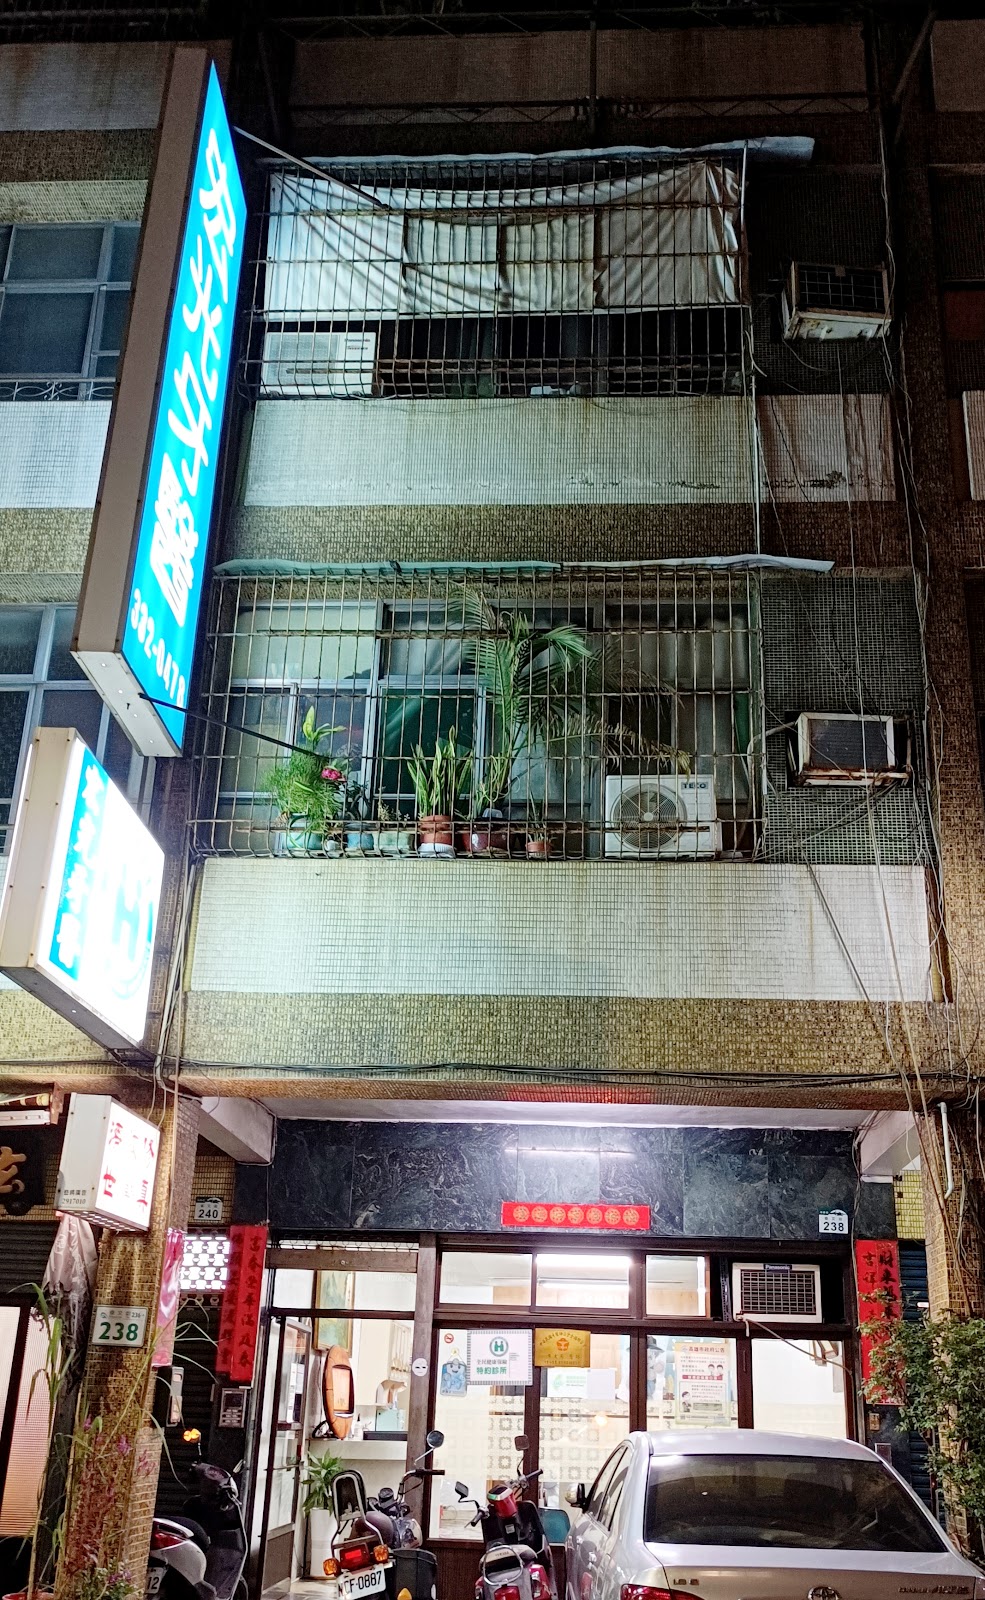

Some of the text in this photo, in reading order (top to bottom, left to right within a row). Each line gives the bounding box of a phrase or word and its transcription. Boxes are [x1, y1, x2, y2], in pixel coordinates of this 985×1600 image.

[150, 128, 236, 627] 宏光牙醫
[131, 588, 185, 707] 332-0478
[198, 1209, 218, 1218] 240
[823, 1221, 844, 1232] 238
[98, 1321, 139, 1341] 238
[476, 1366, 507, 1375] 特約診所
[337, 1570, 382, 1597] NCF-0887
